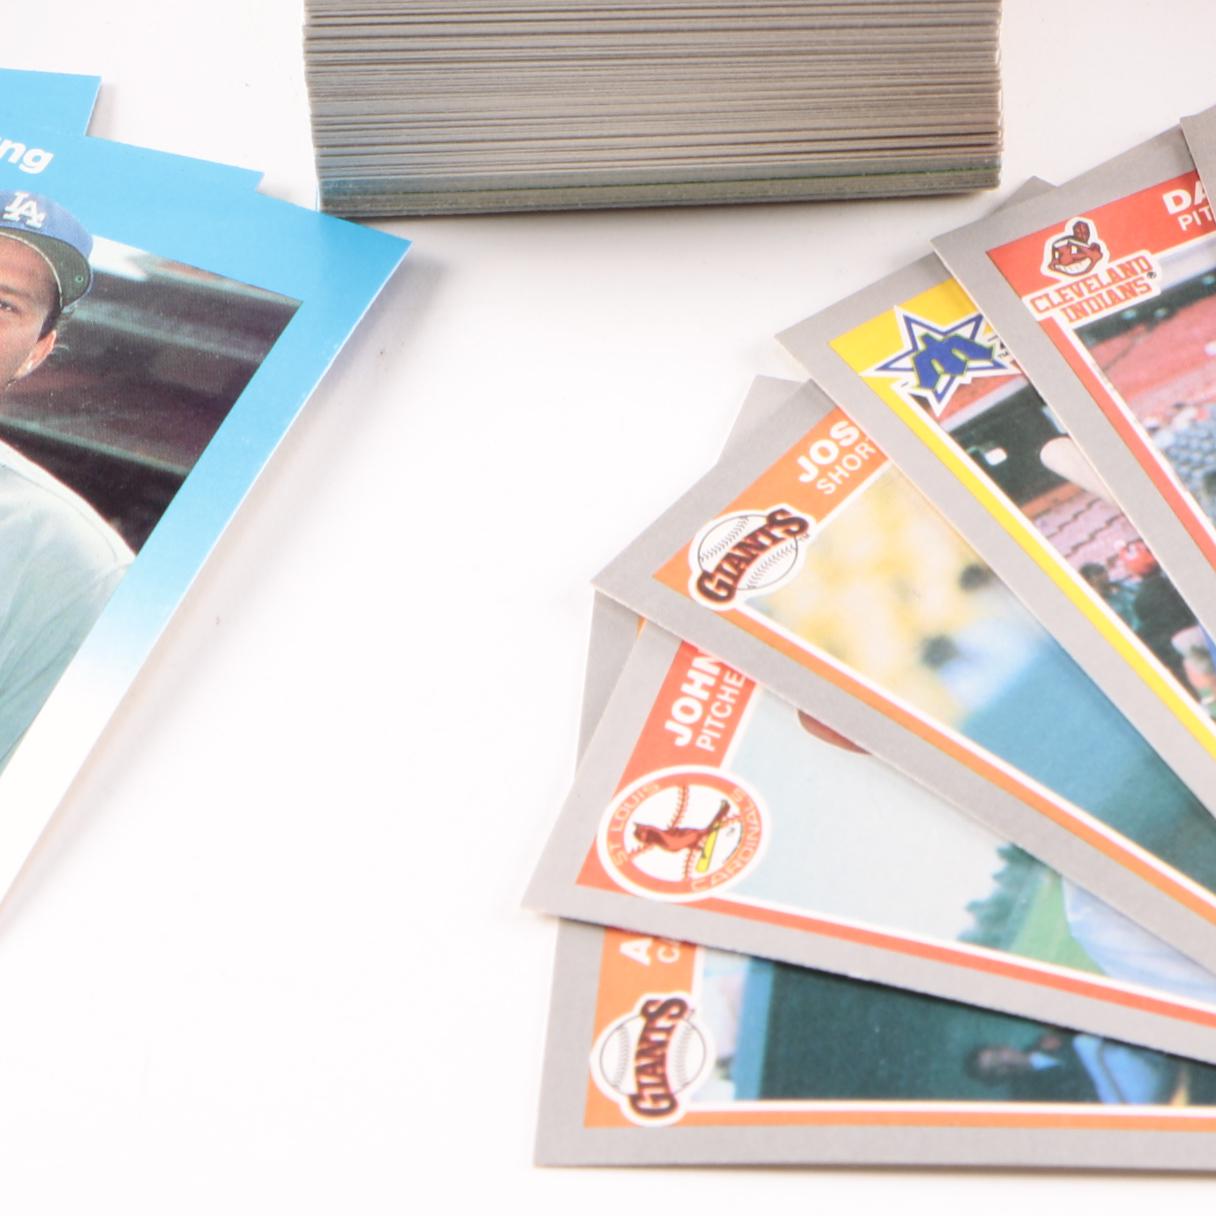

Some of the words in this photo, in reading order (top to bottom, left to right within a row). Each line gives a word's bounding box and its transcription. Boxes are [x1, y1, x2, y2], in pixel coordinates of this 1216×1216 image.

[1029, 255, 1153, 314] CLEVELAND
[1060, 276, 1152, 323] INDIANS
[797, 420, 860, 483] JOS
[696, 507, 809, 604] GIANTS
[628, 998, 688, 1117] GIANTS
